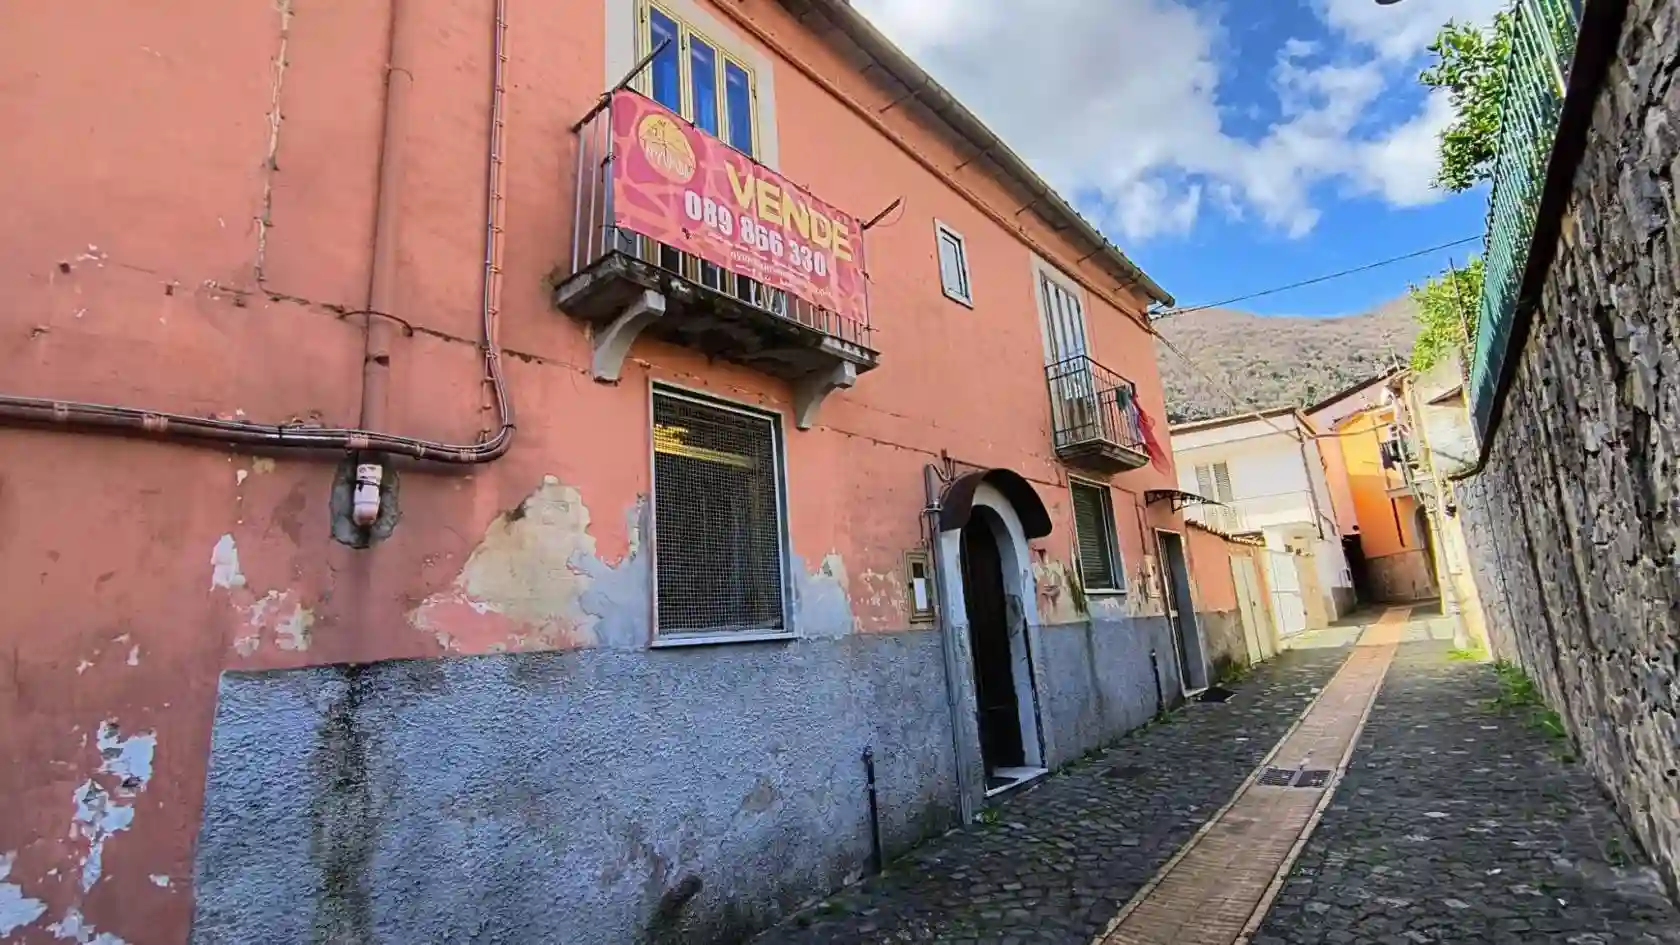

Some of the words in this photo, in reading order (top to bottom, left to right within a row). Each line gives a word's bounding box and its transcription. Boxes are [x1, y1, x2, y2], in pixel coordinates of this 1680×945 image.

[685, 189, 733, 237] 089
[740, 216, 784, 257] 866
[789, 239, 827, 277] 330
[724, 159, 852, 262] VENDE
